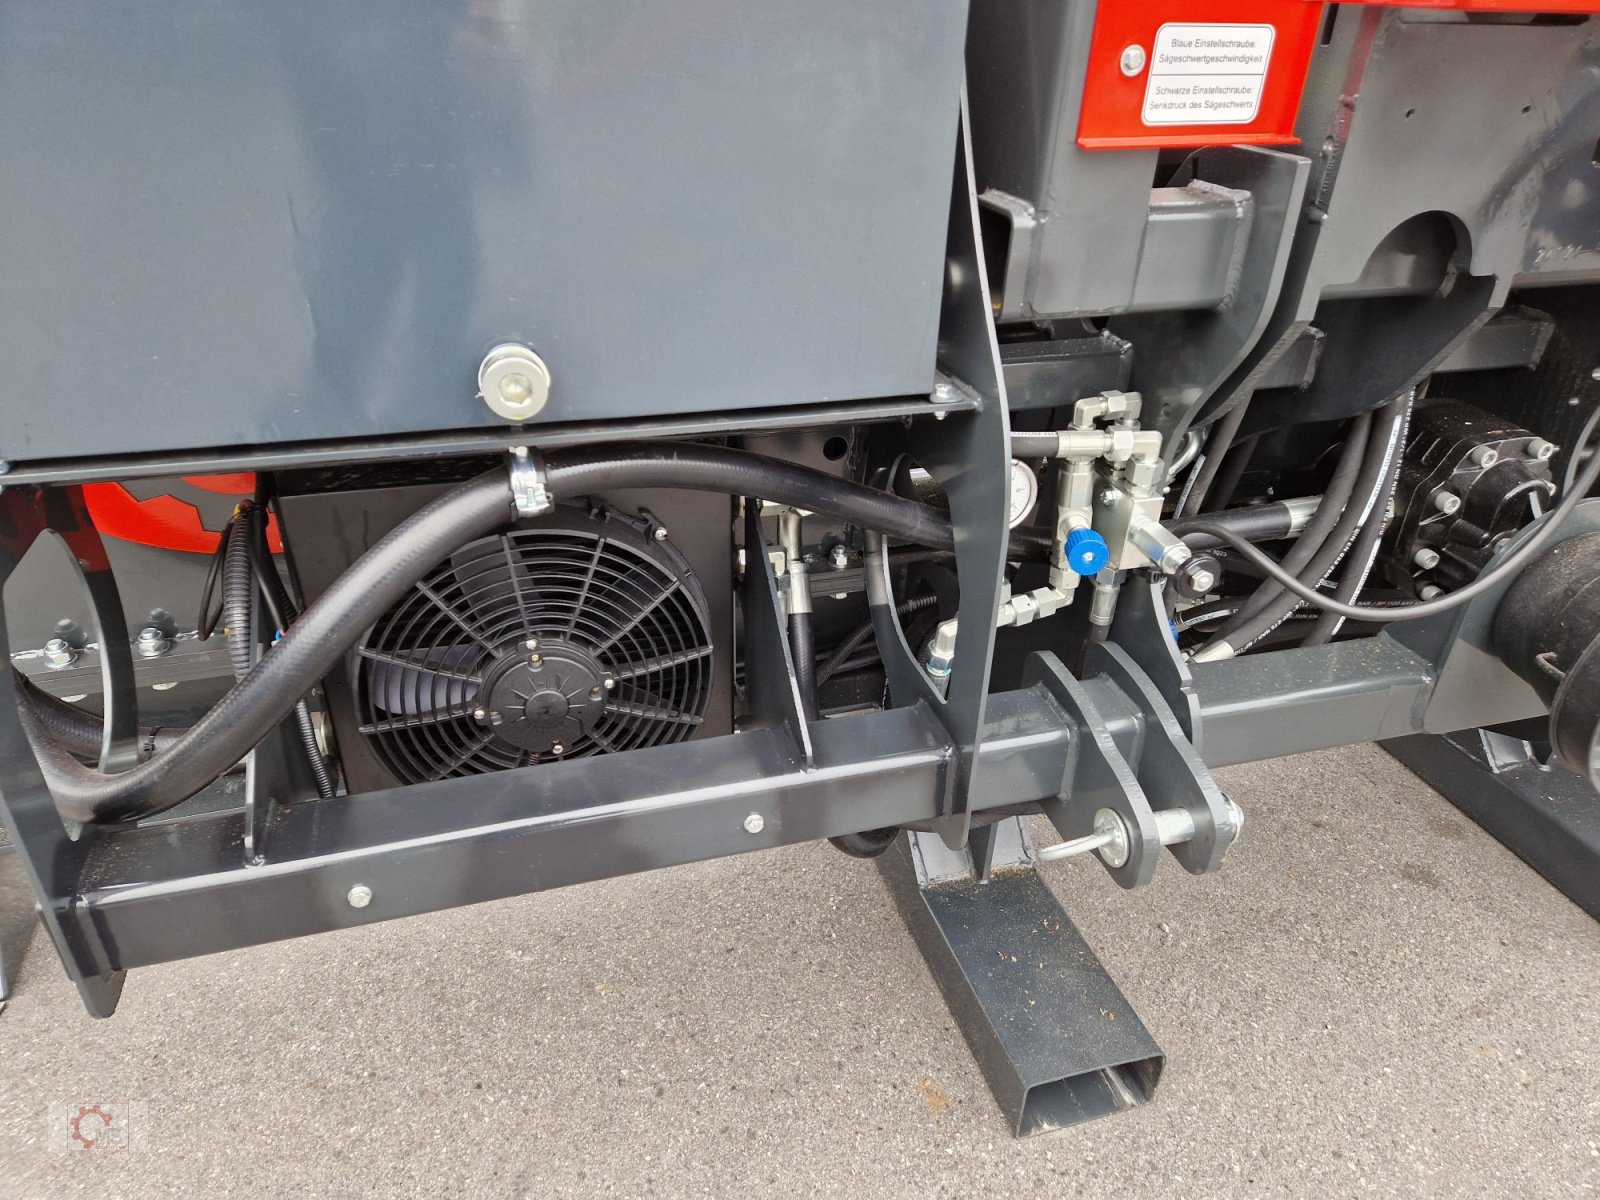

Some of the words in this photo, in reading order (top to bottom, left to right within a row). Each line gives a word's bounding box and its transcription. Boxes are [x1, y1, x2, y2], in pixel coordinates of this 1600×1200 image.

[1171, 38, 1193, 48] Blaue
[1194, 38, 1257, 48] Einstellschraube:
[1158, 53, 1263, 65] Sägeschwertgeschwindigkeit
[1155, 86, 1191, 95] Schwarze
[1192, 85, 1253, 95] Einstellschraube:
[1149, 101, 1187, 110] Senkdruck
[1189, 100, 1202, 109] des
[1204, 100, 1253, 111] Sägeschwerts
